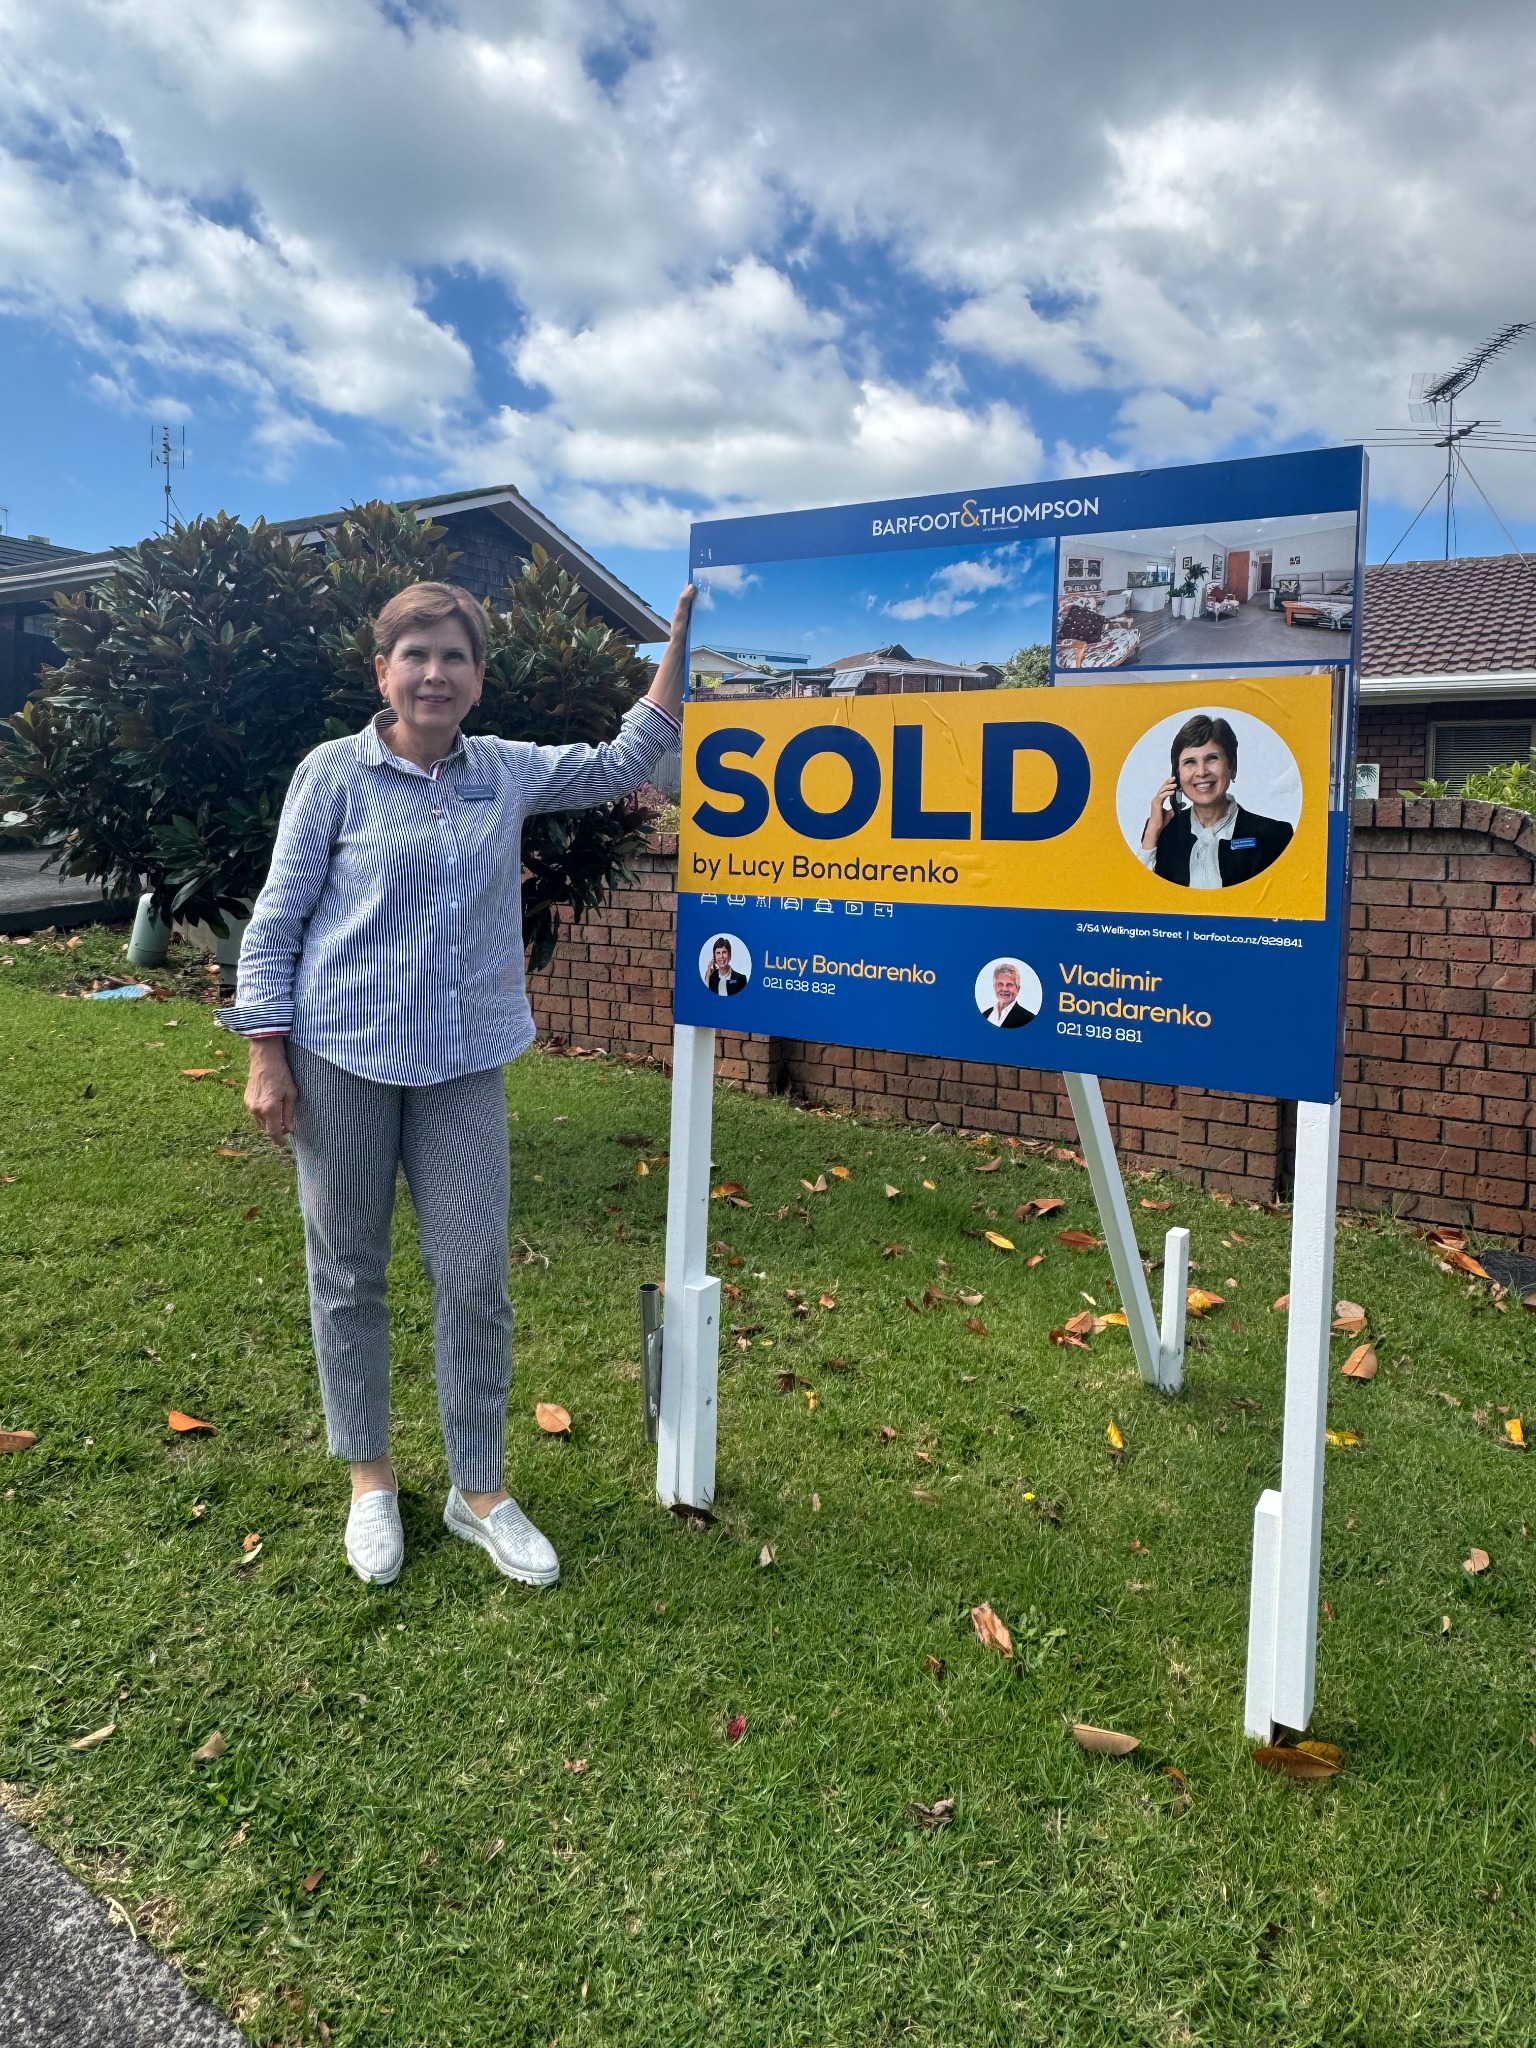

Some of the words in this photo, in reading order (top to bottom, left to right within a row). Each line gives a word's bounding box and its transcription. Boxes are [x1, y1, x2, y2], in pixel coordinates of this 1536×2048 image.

[692, 721, 1091, 841] SOLD
[692, 852, 721, 880] by
[728, 854, 785, 883] Lucy
[792, 856, 959, 884] Bondarenko
[1076, 923, 1100, 933] 3/54
[1101, 924, 1150, 938] Wellington
[1152, 928, 1182, 939] Street
[763, 950, 808, 977] Lucy
[812, 954, 937, 985] Bondarenko
[1058, 962, 1163, 992] Vladimir
[763, 977, 784, 990] 021
[785, 979, 809, 992] 638
[811, 982, 836, 994] 832
[1058, 991, 1212, 1028] Bondarenko
[1056, 1021, 1082, 1036] 021
[1085, 1024, 1112, 1040] 918
[1115, 1028, 1143, 1043] 881
